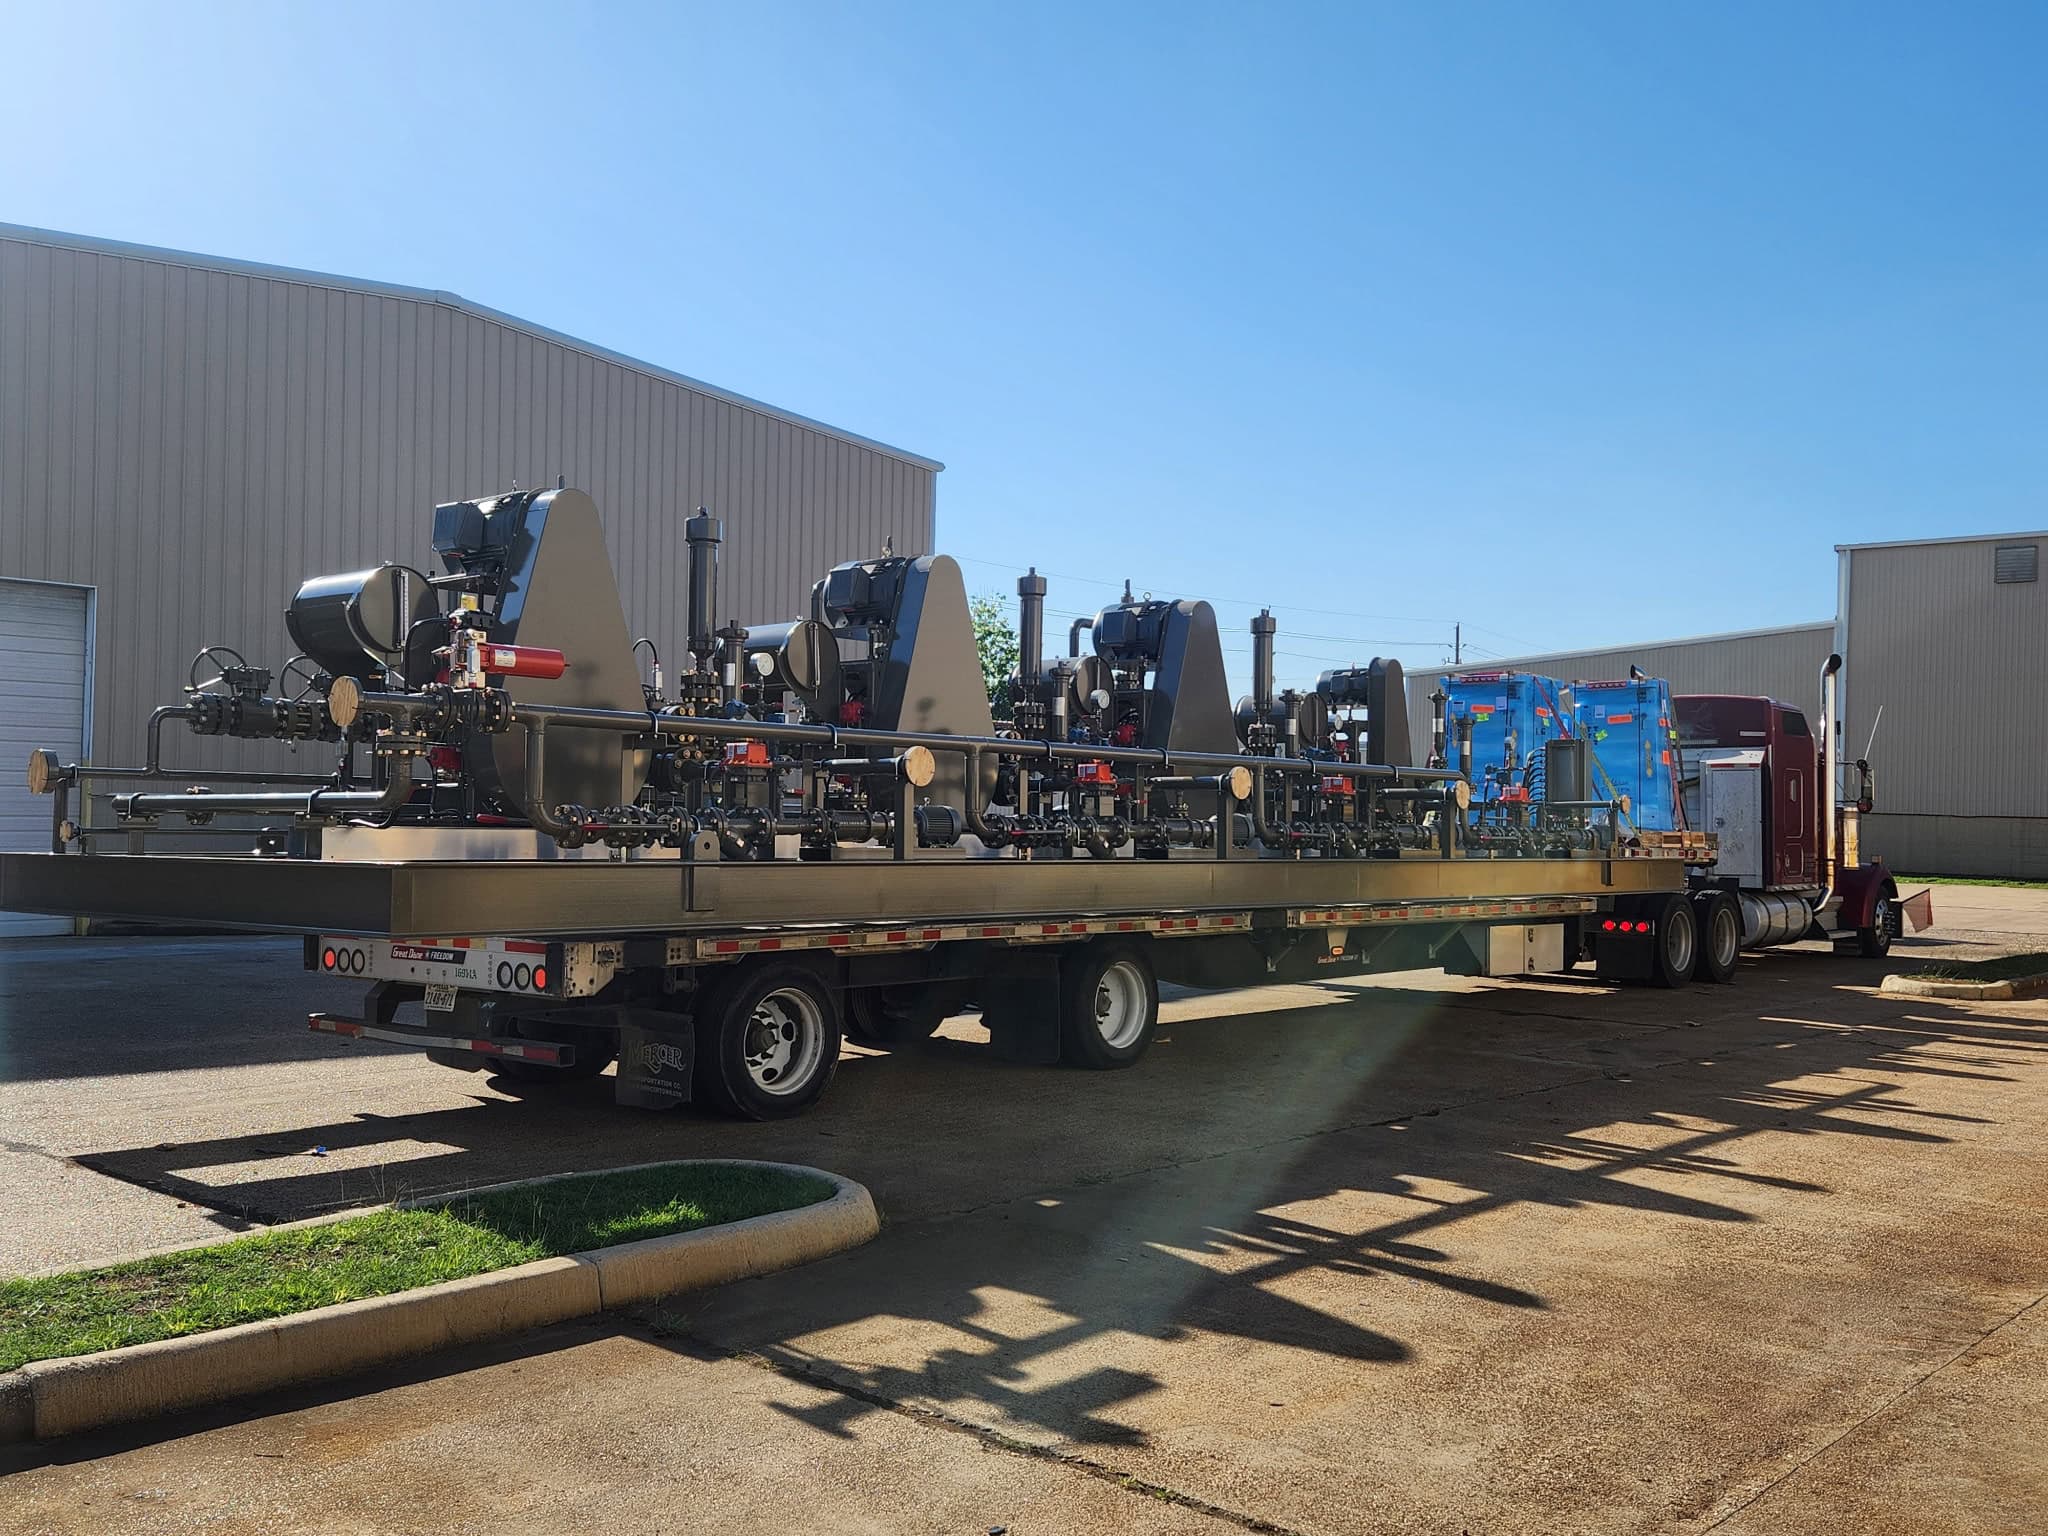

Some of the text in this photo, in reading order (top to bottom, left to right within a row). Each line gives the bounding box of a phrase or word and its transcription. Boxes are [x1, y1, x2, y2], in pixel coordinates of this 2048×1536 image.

[392, 946, 454, 961] Great Dane FREEDOM
[627, 1041, 686, 1074] MERCER
